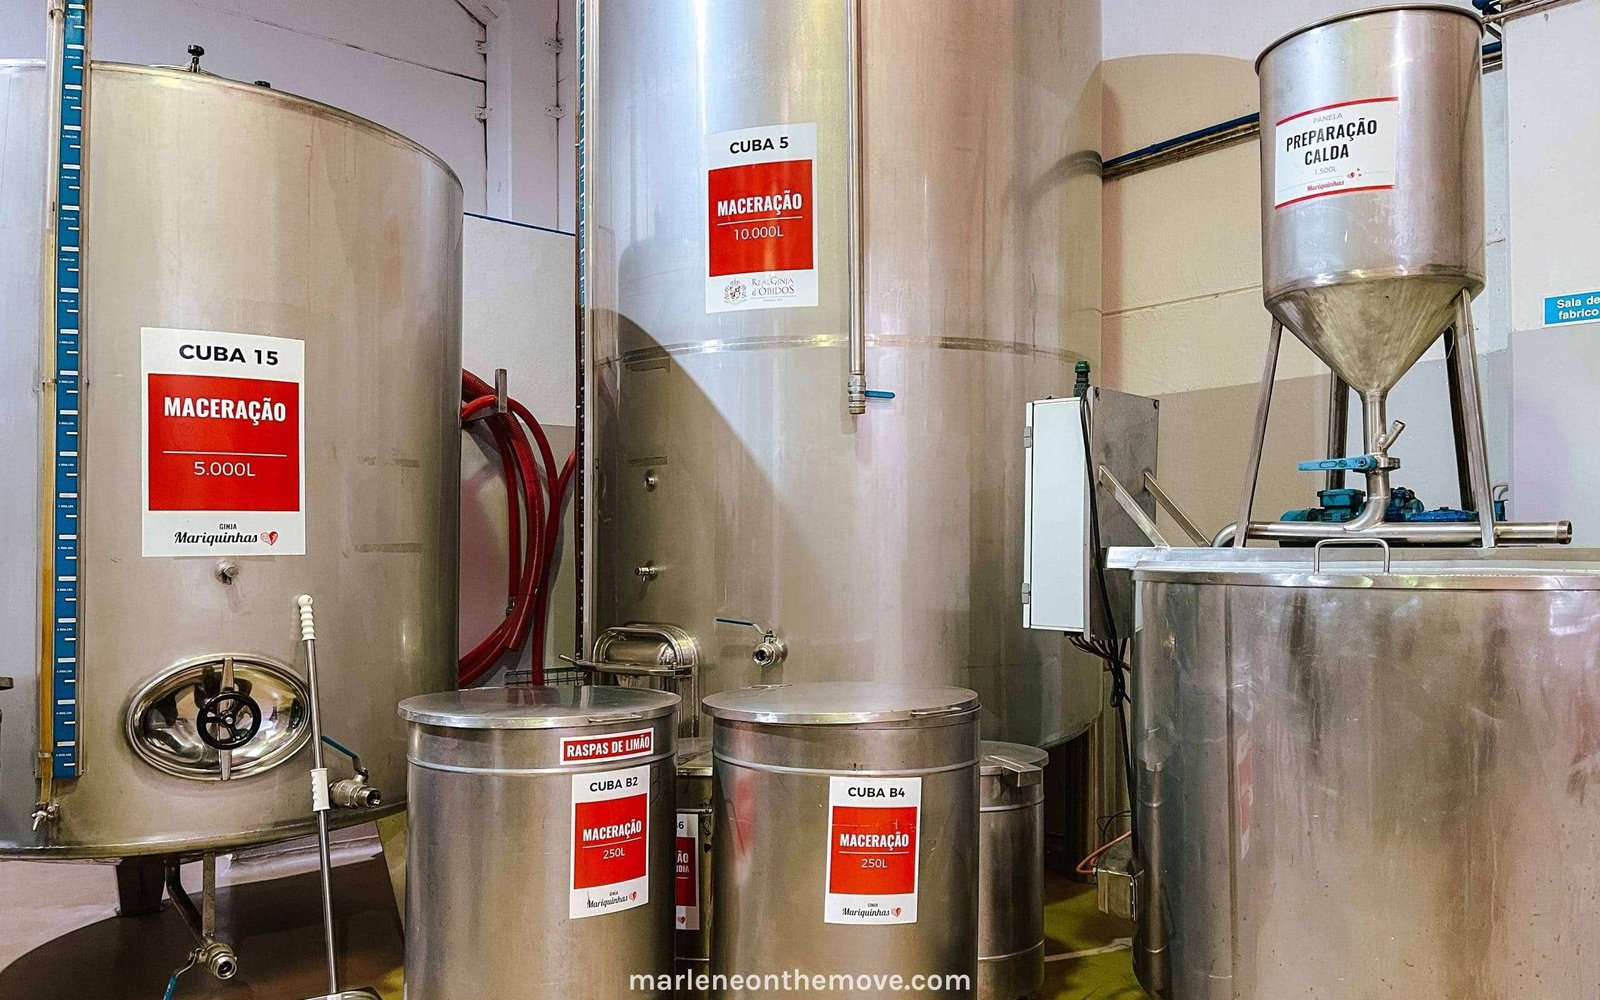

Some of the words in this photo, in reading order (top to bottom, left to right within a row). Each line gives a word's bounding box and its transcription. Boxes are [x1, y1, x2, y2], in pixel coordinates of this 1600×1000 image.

[1313, 112, 1343, 123] PANELA
[1286, 118, 1377, 152] PREPARAÇÃO
[729, 138, 774, 154] CUBA
[780, 136, 789, 149] 5
[1304, 144, 1349, 165] CALDA
[717, 190, 803, 217] MACERAÇÃO
[734, 226, 784, 240] 10.000L
[1556, 298, 1582, 309] Sala
[1586, 296, 1600, 305] de
[1558, 308, 1599, 320] fabrico
[179, 344, 246, 363] CUBA
[254, 349, 279, 366] 15
[163, 396, 287, 426] MACERAÇÃO
[193, 461, 256, 478] 5.000L
[174, 530, 258, 547] Mariquinhas
[567, 742, 609, 758] RASPAS
[612, 740, 623, 753] DE
[625, 735, 650, 752] LIMÃO
[589, 779, 623, 792] CUBA
[625, 776, 639, 788] B2
[848, 787, 885, 798] CUBA
[889, 787, 905, 798] B4
[583, 818, 642, 841] MACERAÇÃO
[840, 831, 909, 851] MACERAÇÃO
[603, 848, 625, 860] 250L
[861, 858, 888, 869] 250L
[587, 896, 628, 908] Mariquinhas
[841, 907, 890, 918] Mariquinhas
